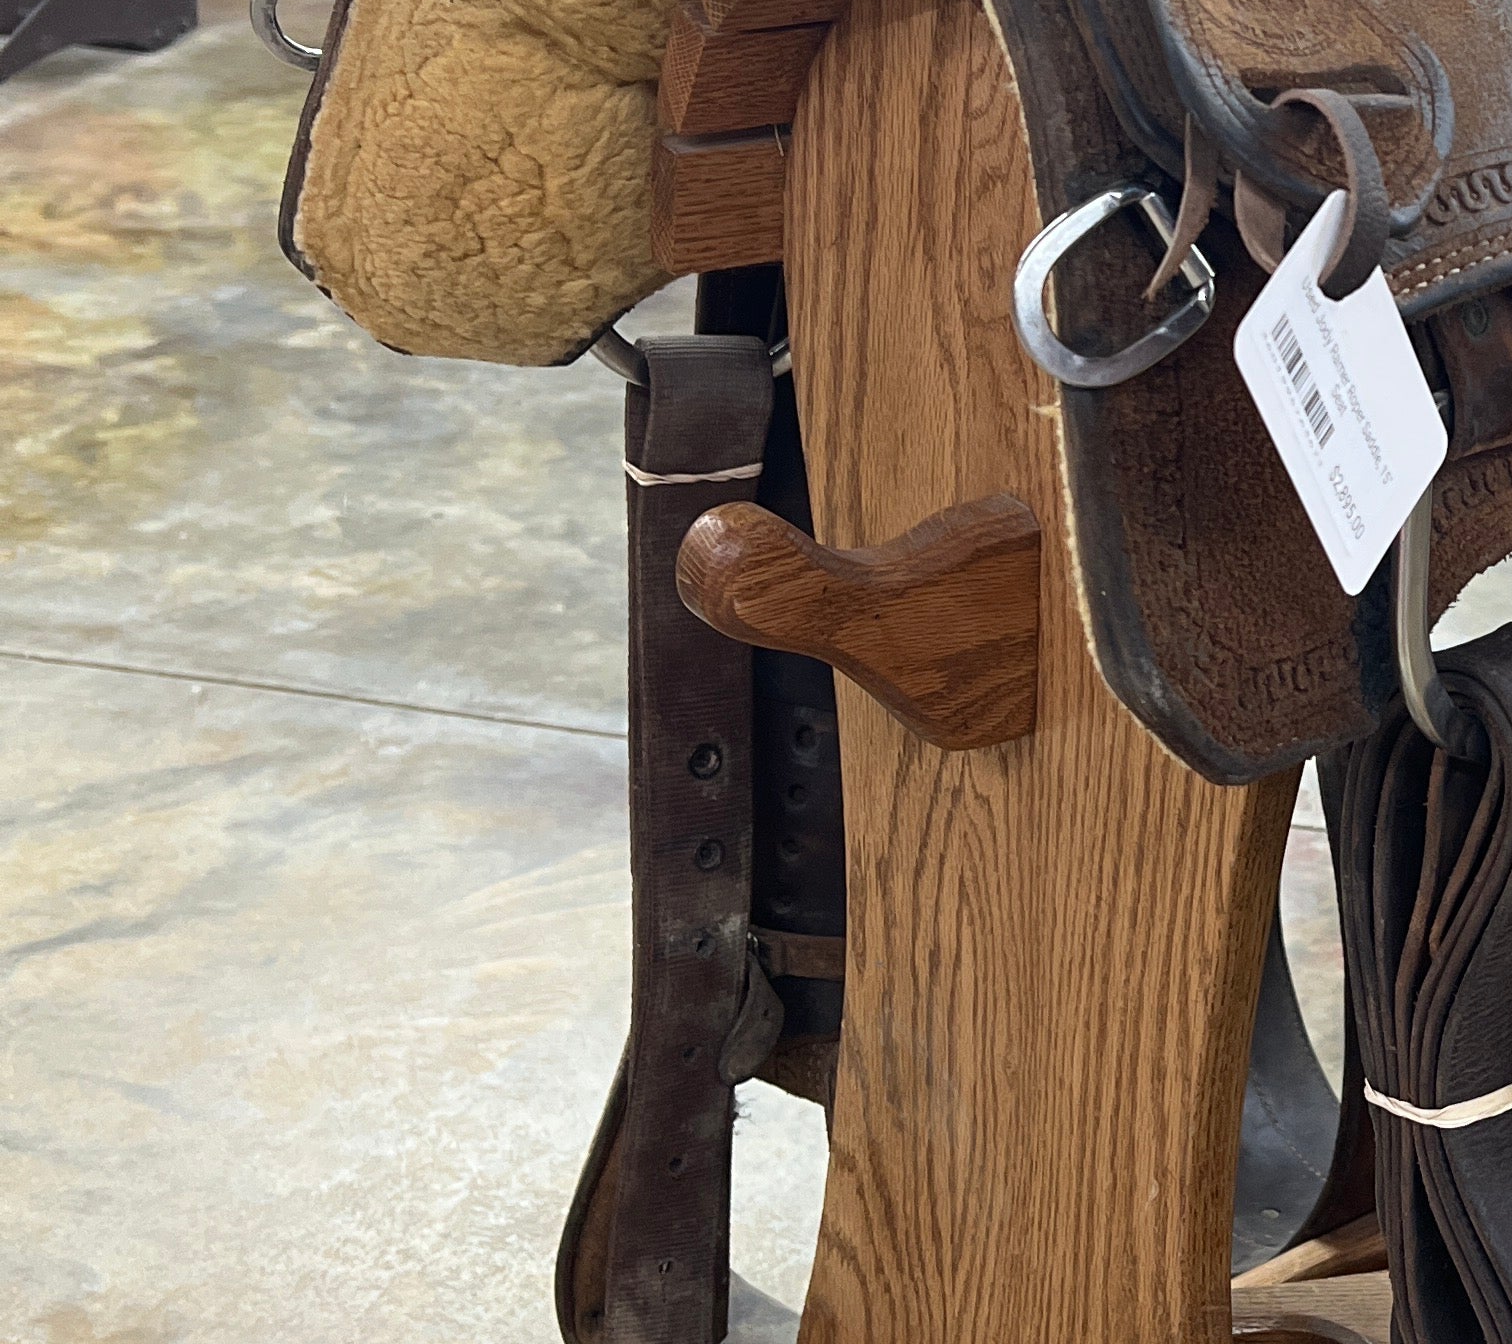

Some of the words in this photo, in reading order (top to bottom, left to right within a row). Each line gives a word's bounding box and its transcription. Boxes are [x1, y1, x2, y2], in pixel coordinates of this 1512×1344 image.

[1302, 274, 1320, 313] Used
[1316, 313, 1333, 347] Jody
[1347, 384, 1365, 424] Roper
[1331, 383, 1347, 416] Seat
[1329, 465, 1365, 540] $2,895.00
